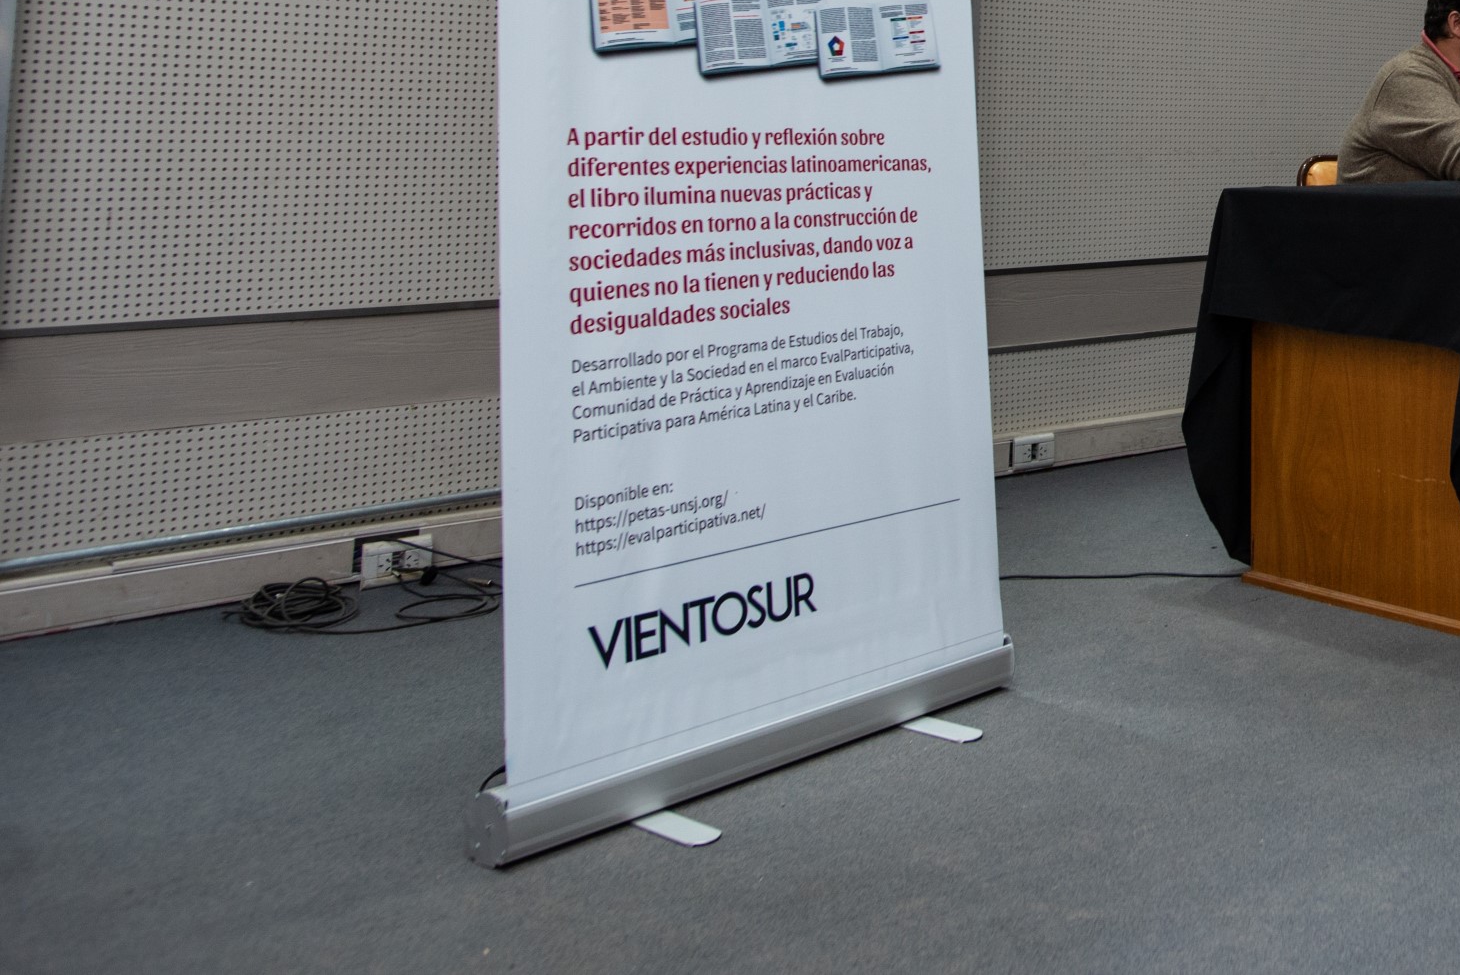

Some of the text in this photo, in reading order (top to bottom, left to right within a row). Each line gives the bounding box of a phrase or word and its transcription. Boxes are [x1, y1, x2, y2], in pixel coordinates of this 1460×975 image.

[567, 126, 885, 150] A partir del estudio y reflexión sobre
[568, 154, 931, 179] diferentes experiencias latinoamericanas,
[568, 182, 872, 208] el libro ilumina nuevas prácticas y
[569, 207, 918, 239] recorridos en torno a la construcción de
[569, 235, 913, 271] sociedades más inclusivas, dando voz a
[570, 261, 895, 307] quienes no la tienen y reduciendo las
[570, 297, 790, 335] desigualdades sociales
[572, 324, 904, 374] Desarrollado por el Programa de Estudios del Trabajo,
[572, 343, 914, 397] el Ambiente y la Sociedad en el marco EvalParticipativa,
[572, 364, 894, 420] Comunidad de Práctica y Aprendizaje en Evaluación
[573, 390, 856, 443] Participativa para América Latina y el Caribe.
[575, 483, 673, 511] Disponible en:
[575, 490, 728, 534] https://petas-unsj.org/
[576, 503, 766, 556] https://evalparticipativa.net/
[588, 572, 817, 668] VIENTOSUR
